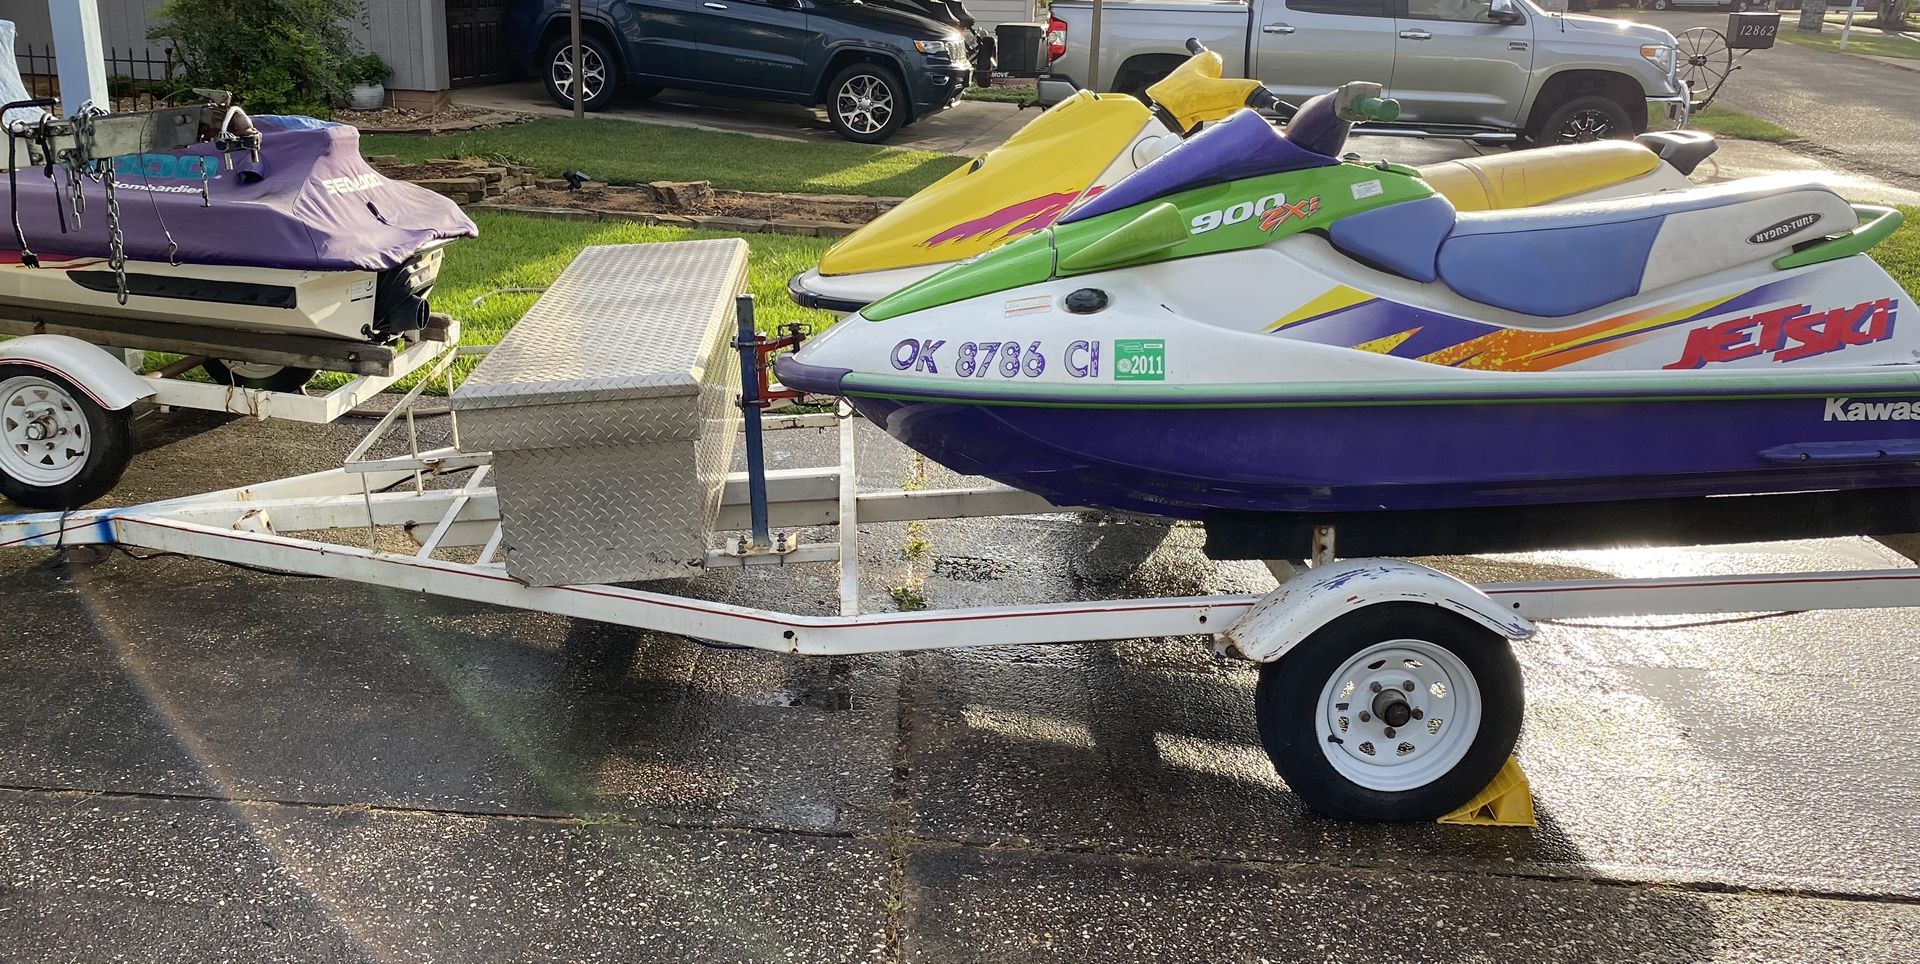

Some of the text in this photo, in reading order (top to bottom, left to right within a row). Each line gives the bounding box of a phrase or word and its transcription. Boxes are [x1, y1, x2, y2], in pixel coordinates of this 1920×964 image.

[1740, 25, 1775, 36] 12862
[1190, 192, 1287, 235] 900
[1756, 214, 1814, 243] HYDRO-TURF
[890, 338, 1100, 378] OK 8786 CI
[1131, 355, 1163, 375] 2011
[1823, 397, 1920, 422] Kawas
